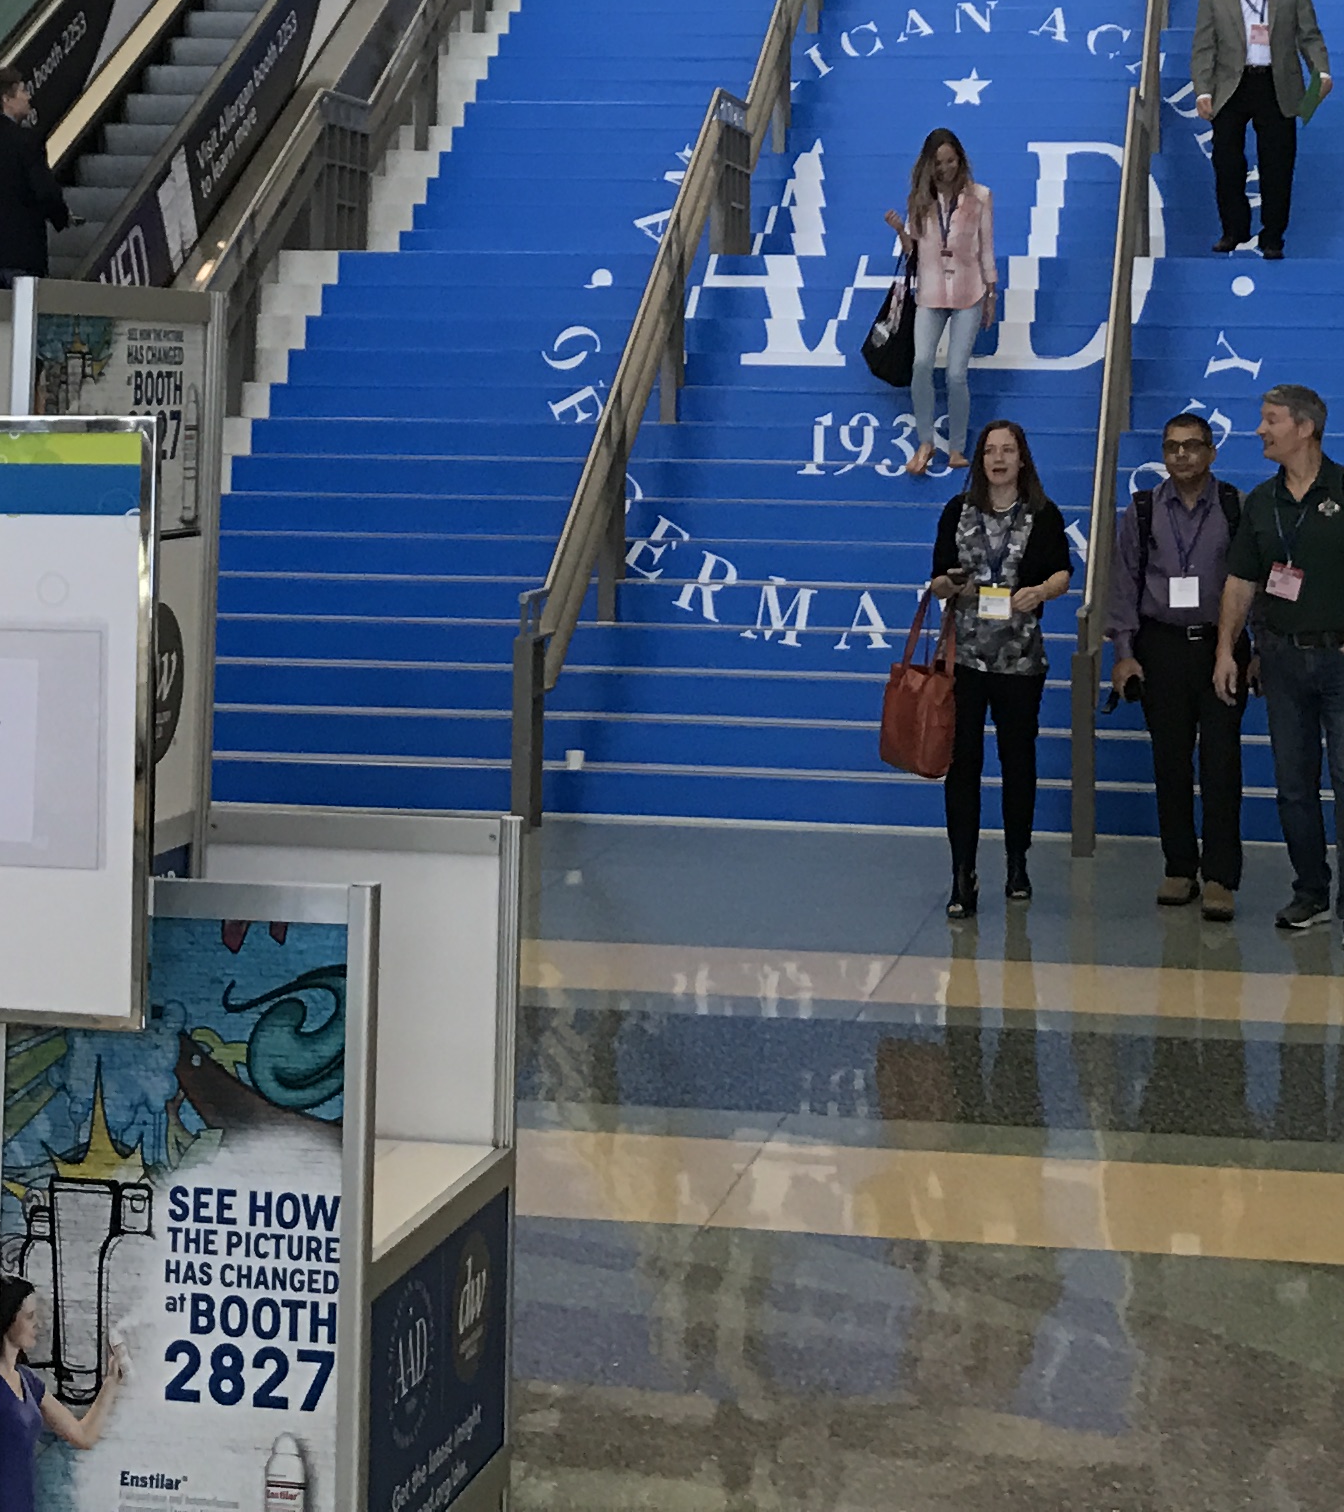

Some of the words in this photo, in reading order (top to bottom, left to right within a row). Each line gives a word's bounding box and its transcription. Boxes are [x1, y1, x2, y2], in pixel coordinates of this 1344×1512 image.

[32, 42, 63, 89] booth
[61, 11, 87, 56] 2253
[127, 345, 145, 365] HAS
[145, 346, 185, 366] CHANGED
[133, 370, 184, 406] BOOTH
[167, 1185, 238, 1226] SEE
[248, 1190, 342, 1232] HOW
[167, 1226, 219, 1256] THE
[226, 1230, 341, 1264] PICTURE
[164, 1259, 213, 1287] HAS
[219, 1263, 340, 1295] CHANGED
[165, 1292, 187, 1313] at
[189, 1292, 338, 1345] BOOTH
[164, 1339, 336, 1413] 2827
[119, 1470, 182, 1491] Enstilar
